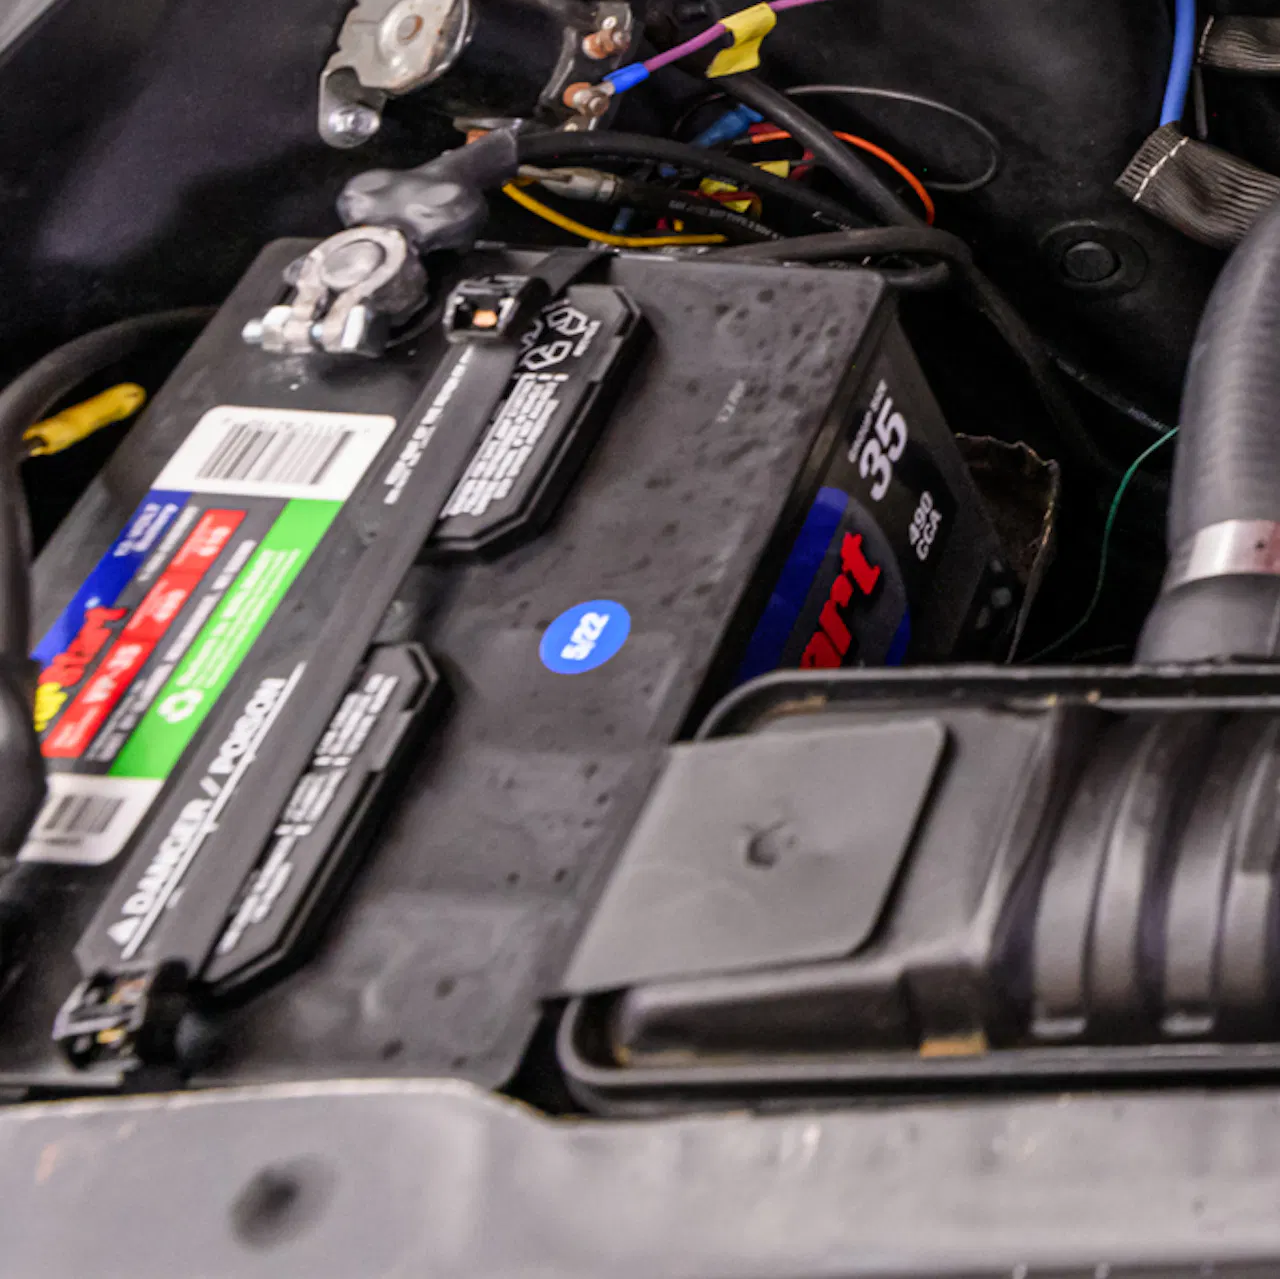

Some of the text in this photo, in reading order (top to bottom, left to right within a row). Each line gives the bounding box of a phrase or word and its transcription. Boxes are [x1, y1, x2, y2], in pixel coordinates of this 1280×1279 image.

[858, 397, 909, 502] 35
[908, 489, 935, 546] 490
[915, 508, 943, 561] CCA
[560, 612, 610, 662] 5/22
[121, 797, 215, 921] DANGER
[209, 677, 287, 776] POISON
